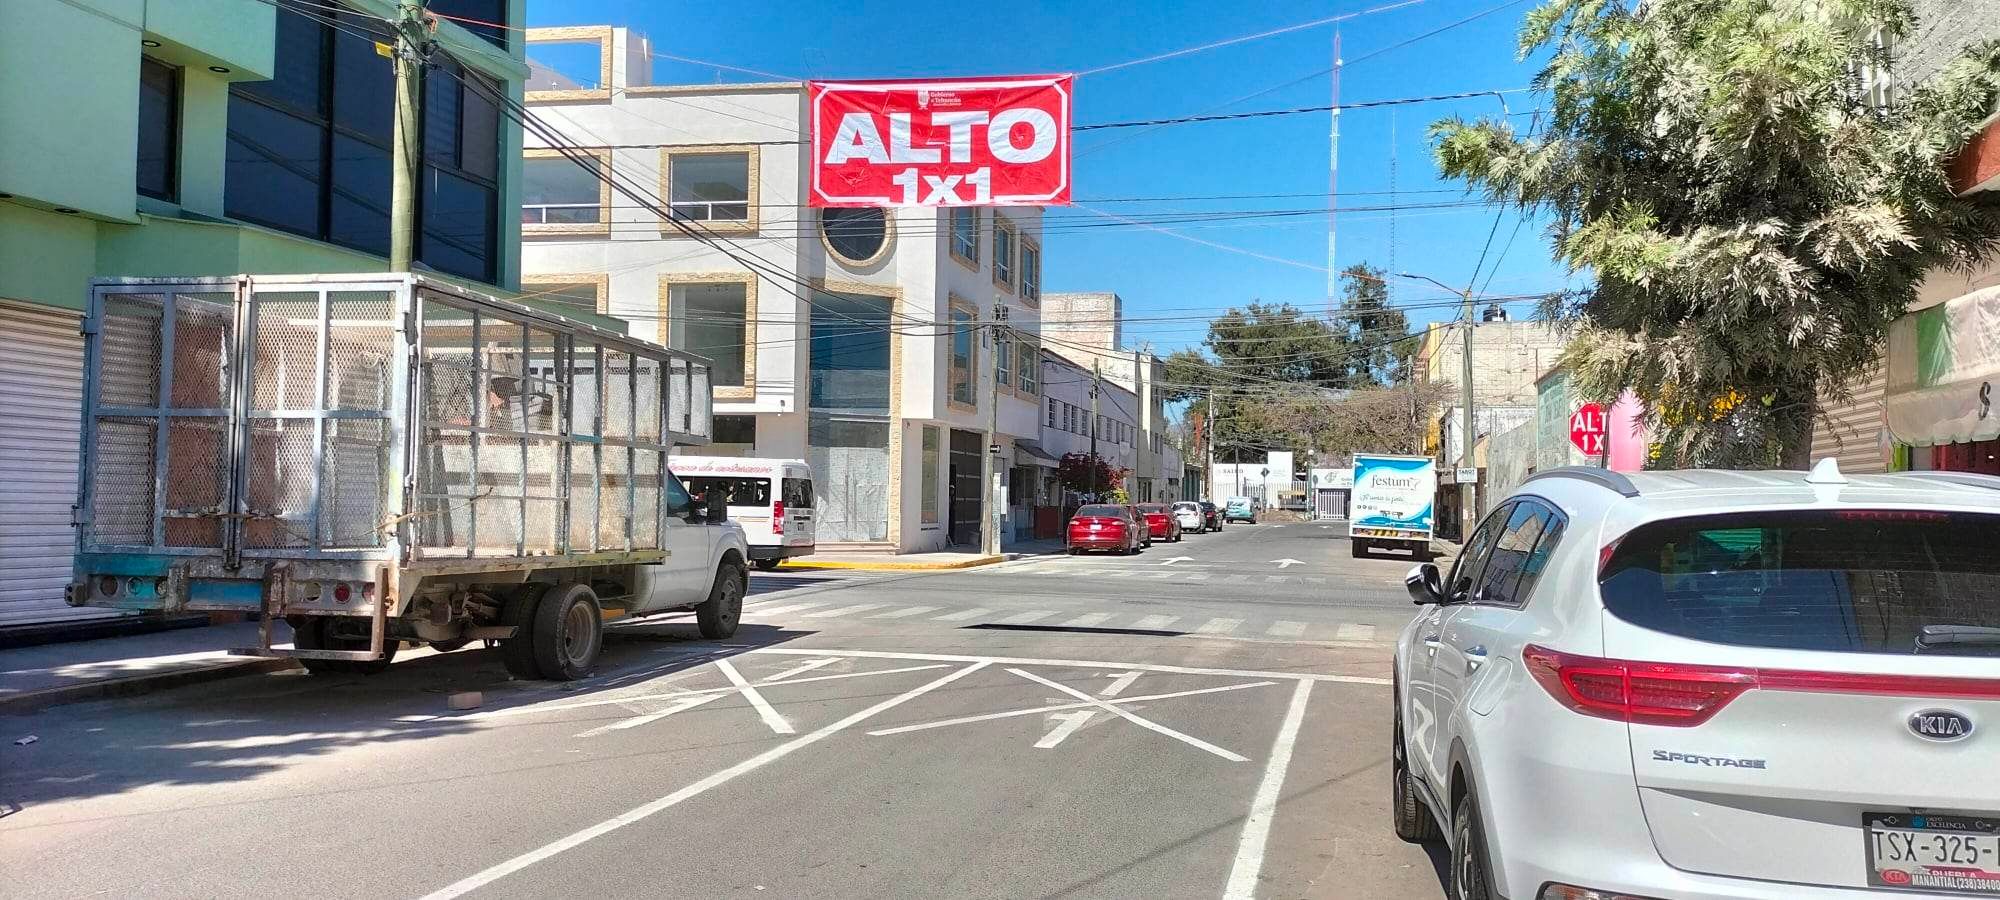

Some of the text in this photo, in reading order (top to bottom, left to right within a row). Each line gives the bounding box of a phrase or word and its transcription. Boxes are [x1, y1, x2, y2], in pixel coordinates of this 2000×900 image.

[824, 107, 1057, 164] ALTO
[893, 167, 992, 205] 1x1
[1573, 411, 1608, 432] ALT
[1582, 434, 1605, 451] 1X
[1372, 474, 1410, 488] festum
[1920, 716, 1963, 735] KIA
[1653, 750, 1767, 769] SPORTAGE
[1926, 821, 1967, 830] EXCELENCIA
[1872, 831, 2000, 866] TSX-325-
